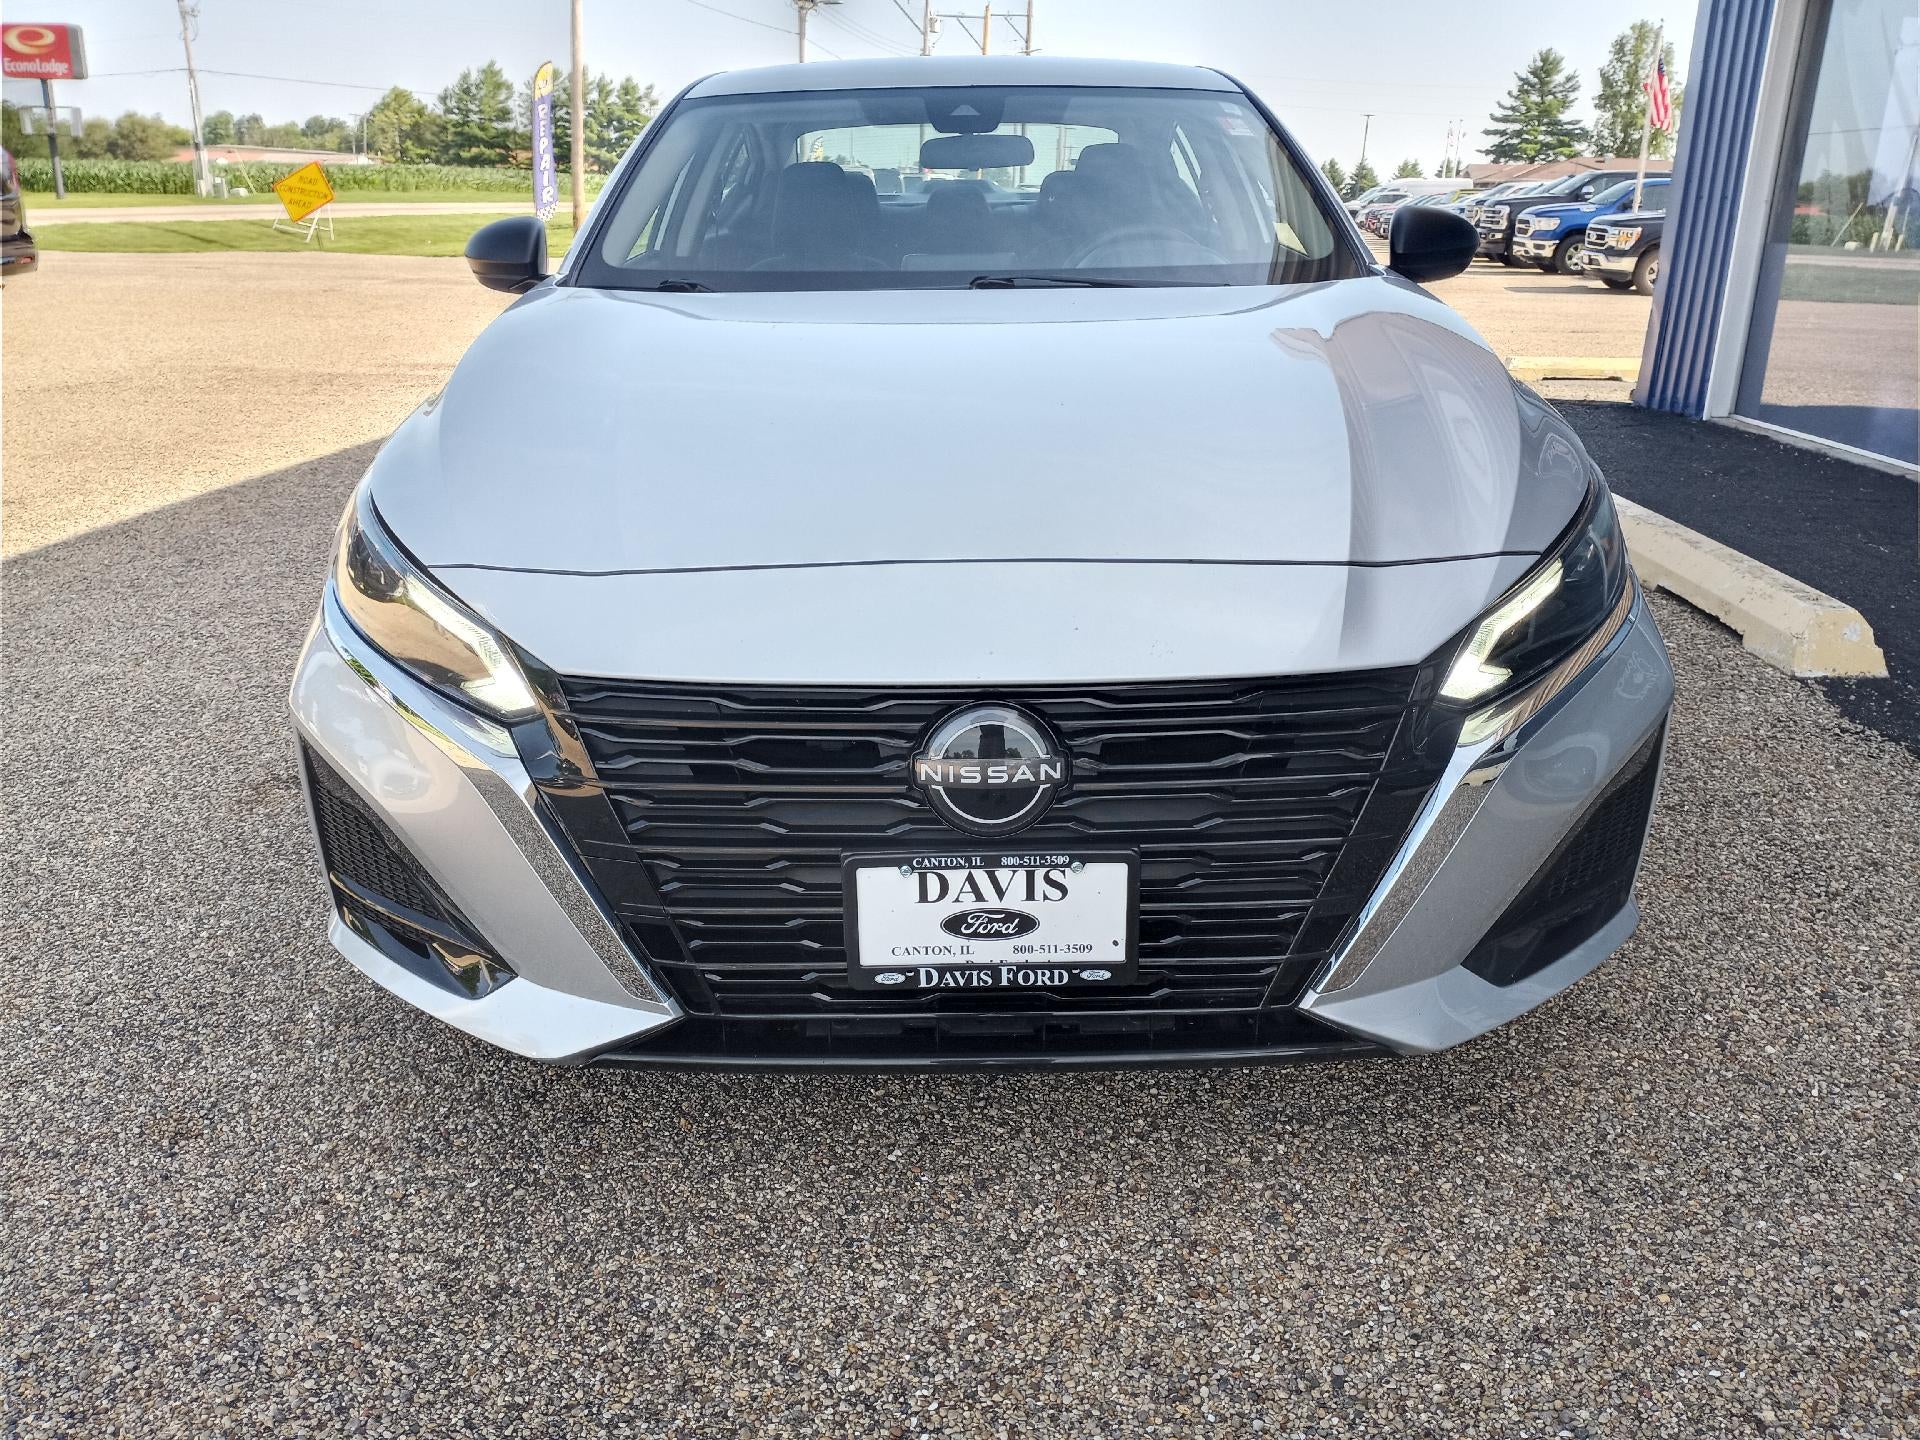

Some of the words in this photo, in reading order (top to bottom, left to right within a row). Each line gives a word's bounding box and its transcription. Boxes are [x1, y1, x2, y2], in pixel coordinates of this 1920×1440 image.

[3, 57, 69, 75] EconoLodge
[537, 103, 555, 204] REPAIR
[298, 175, 319, 185] ROAD
[278, 184, 329, 201] CONSTRUCTION
[288, 198, 312, 209] AHEAD
[919, 762, 1061, 784] NISSAN
[912, 857, 969, 868] CANTON,
[971, 856, 985, 866] IL
[1001, 855, 1070, 866] 800-511-3509
[913, 868, 1069, 904] DAVIS
[960, 912, 1020, 934] Ford
[891, 945, 957, 957] CANTON,
[959, 945, 975, 955] IL
[1012, 943, 1093, 955] 800-511-3509
